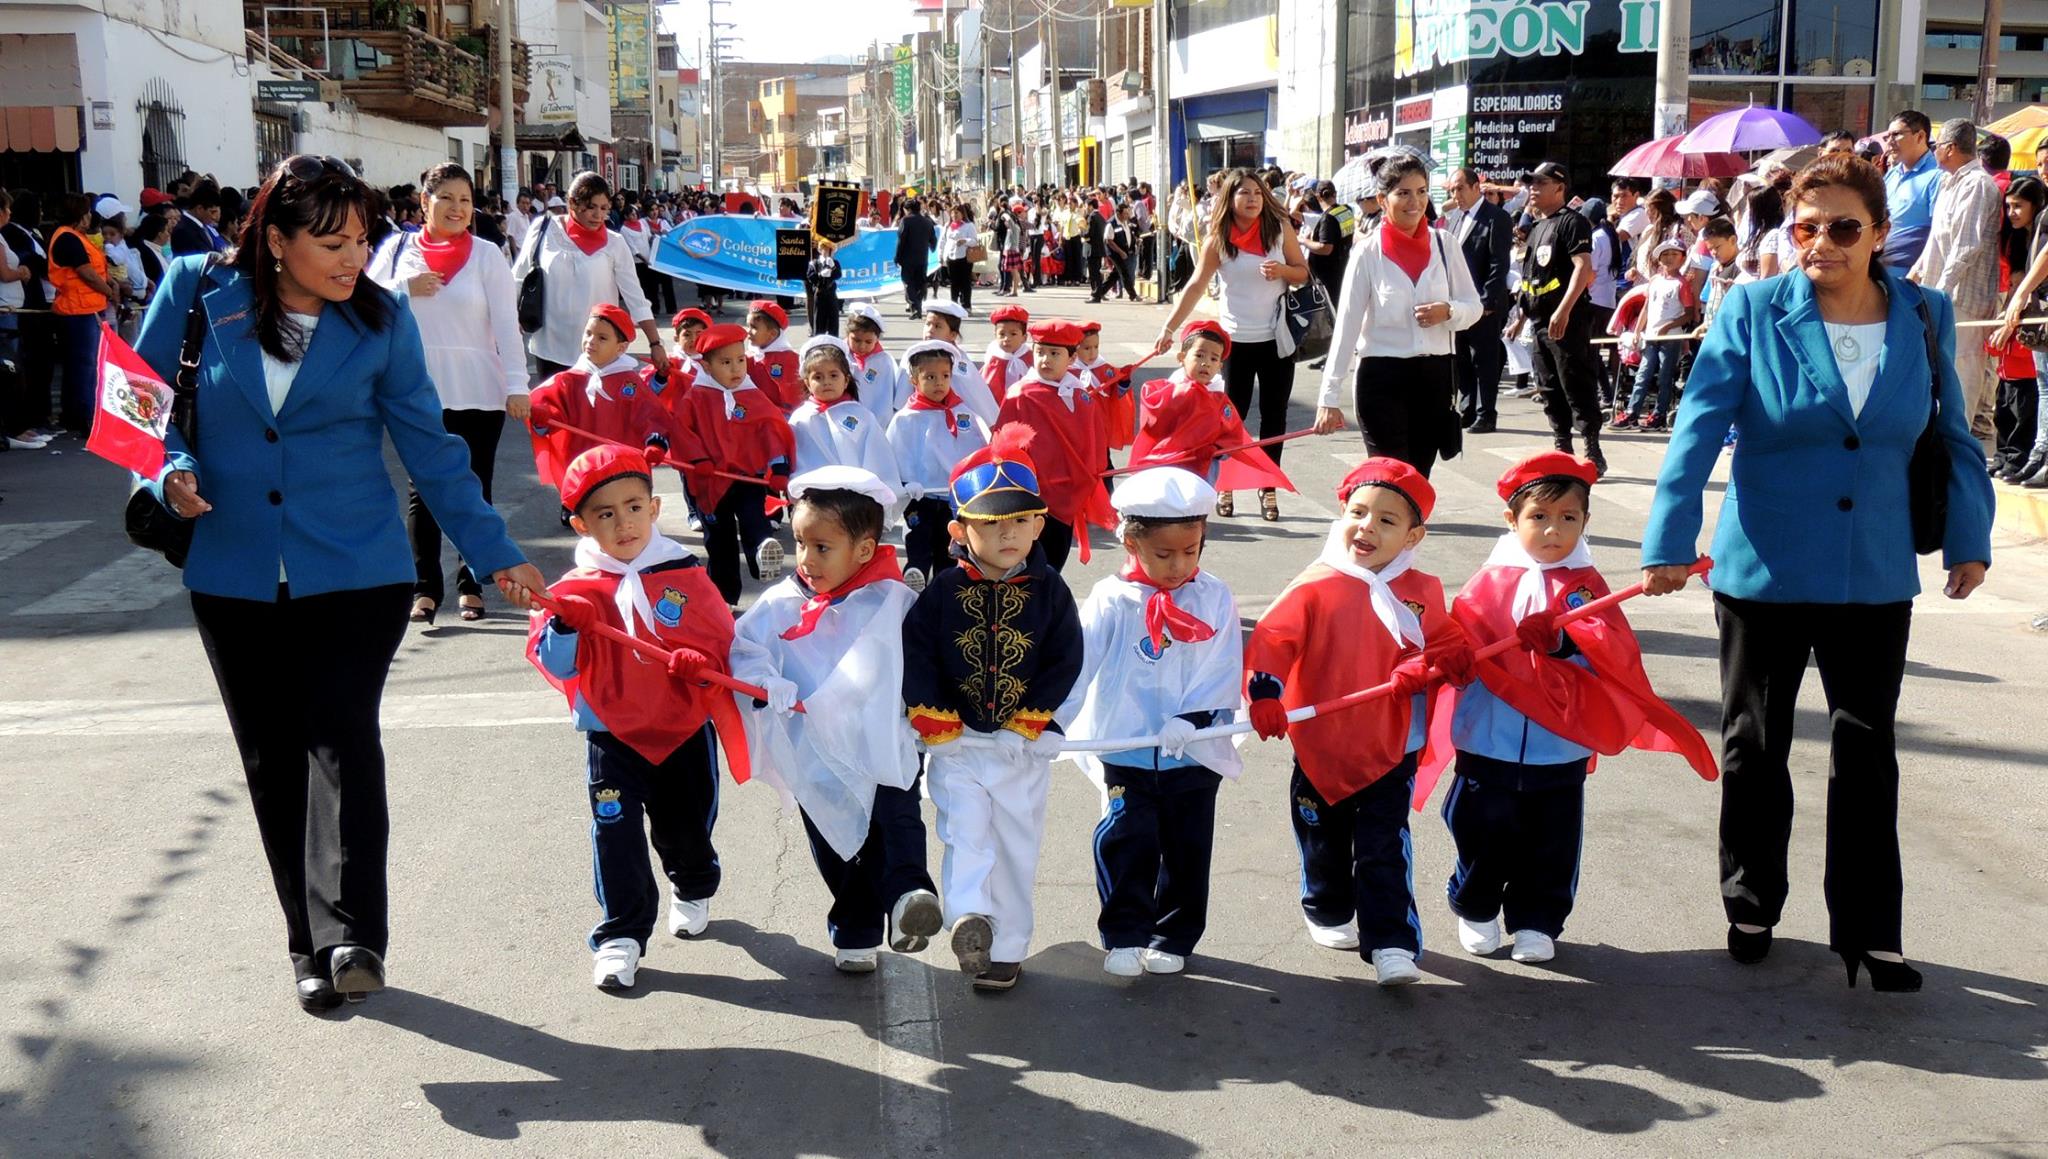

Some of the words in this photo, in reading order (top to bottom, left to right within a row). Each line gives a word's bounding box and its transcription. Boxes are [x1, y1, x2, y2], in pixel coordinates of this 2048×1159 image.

[1473, 95, 1562, 112] ESPECIALIDADES
[1474, 121, 1514, 134] Medicina
[1517, 119, 1556, 133] General
[780, 234, 805, 245] Santa
[722, 238, 773, 257] Colegio
[778, 246, 806, 256] Biblia
